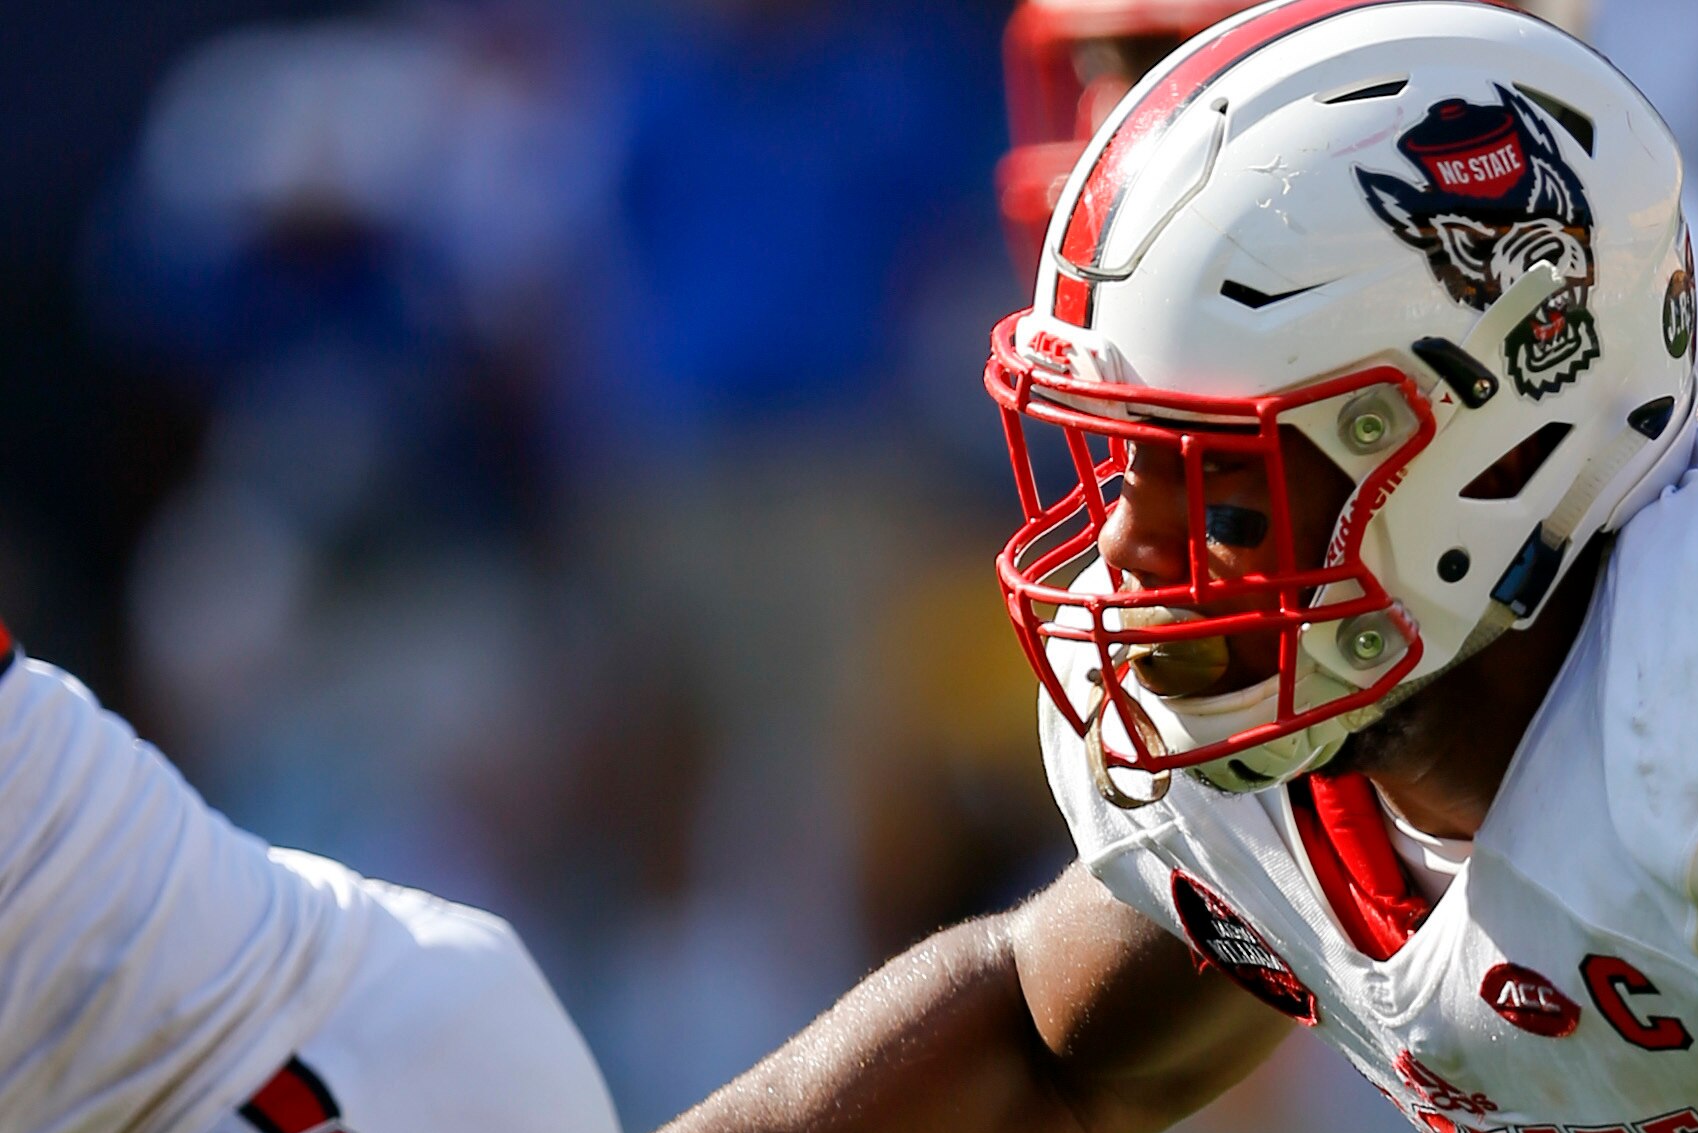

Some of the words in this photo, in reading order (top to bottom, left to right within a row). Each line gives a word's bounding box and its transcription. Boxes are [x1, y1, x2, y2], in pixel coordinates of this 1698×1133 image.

[1436, 160, 1469, 185] NC
[1468, 144, 1521, 182] STATE
[1496, 980, 1561, 1013] ACC
[1578, 953, 1695, 1053] C
